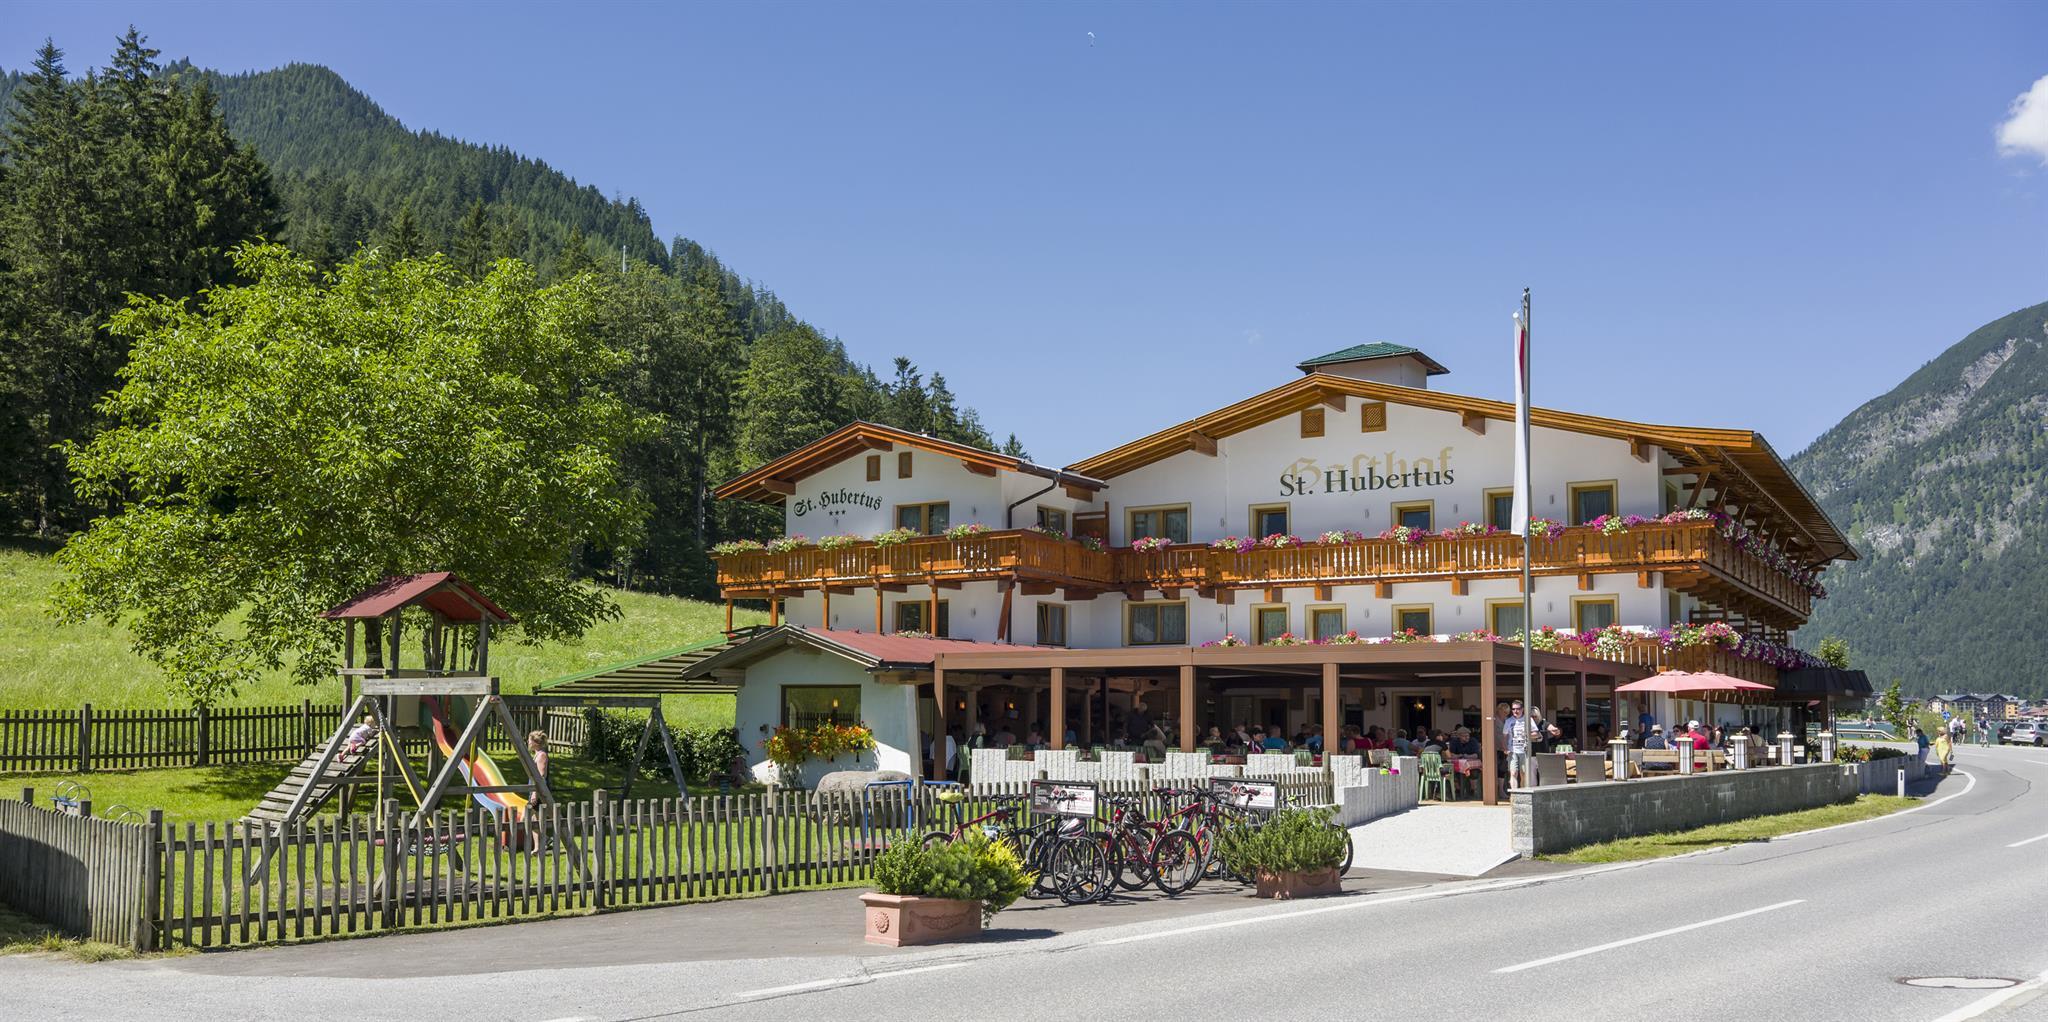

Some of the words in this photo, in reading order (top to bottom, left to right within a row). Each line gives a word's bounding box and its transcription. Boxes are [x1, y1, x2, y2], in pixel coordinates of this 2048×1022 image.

[1280, 473, 1314, 497] St.
[1323, 466, 1455, 494] Hubertus
[793, 498, 817, 517] St.
[819, 488, 883, 511] Hubertus
